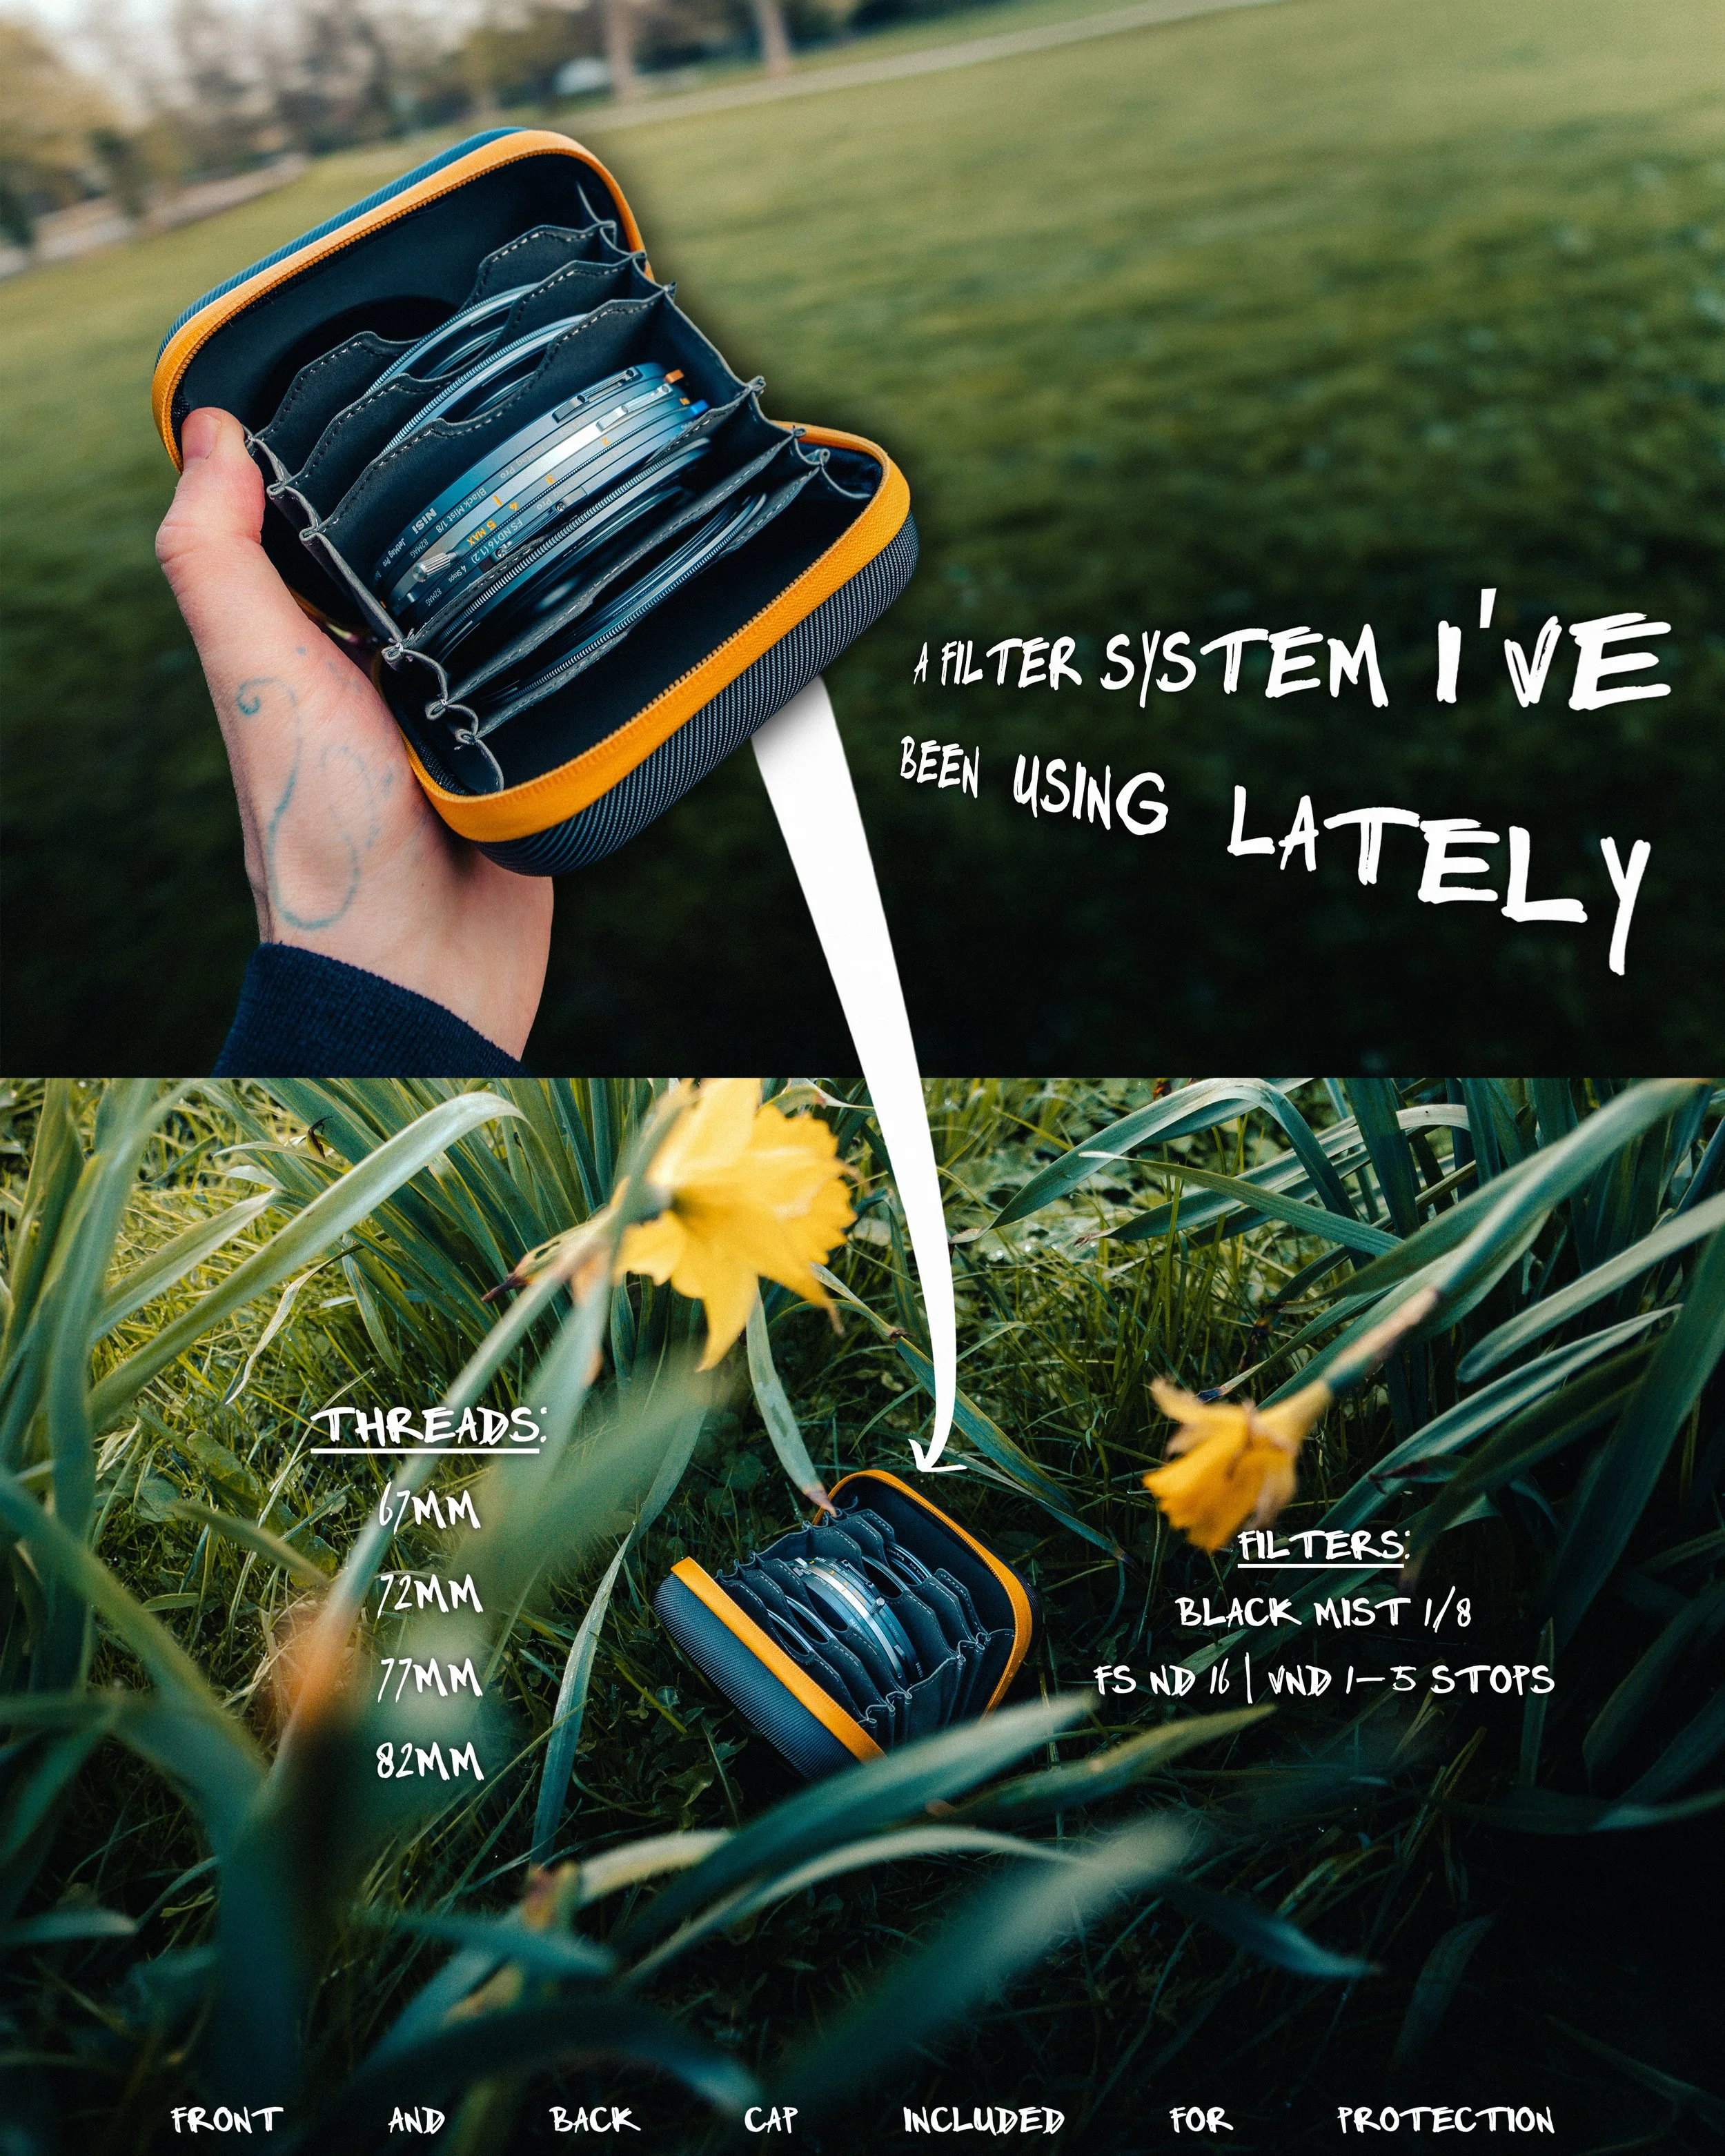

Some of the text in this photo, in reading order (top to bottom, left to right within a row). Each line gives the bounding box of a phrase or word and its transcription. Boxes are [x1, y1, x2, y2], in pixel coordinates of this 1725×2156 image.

[602, 436, 611, 446] 2
[500, 467, 516, 479] Pro
[546, 474, 556, 485] 3
[462, 487, 487, 508] Black
[536, 497, 553, 510] Pro
[446, 504, 466, 522] Mist
[509, 502, 519, 512] 4
[435, 519, 448, 534] 1/8
[511, 518, 524, 531] FS
[382, 508, 437, 567] NiSi JetMag Pro
[466, 519, 497, 546] 5 MAX
[487, 528, 513, 549] ND16
[410, 538, 429, 559] 82MAG
[471, 546, 490, 564] (1.2)
[460, 564, 467, 573] 4
[448, 569, 463, 584] Stops
[425, 588, 443, 606] 82MAG
